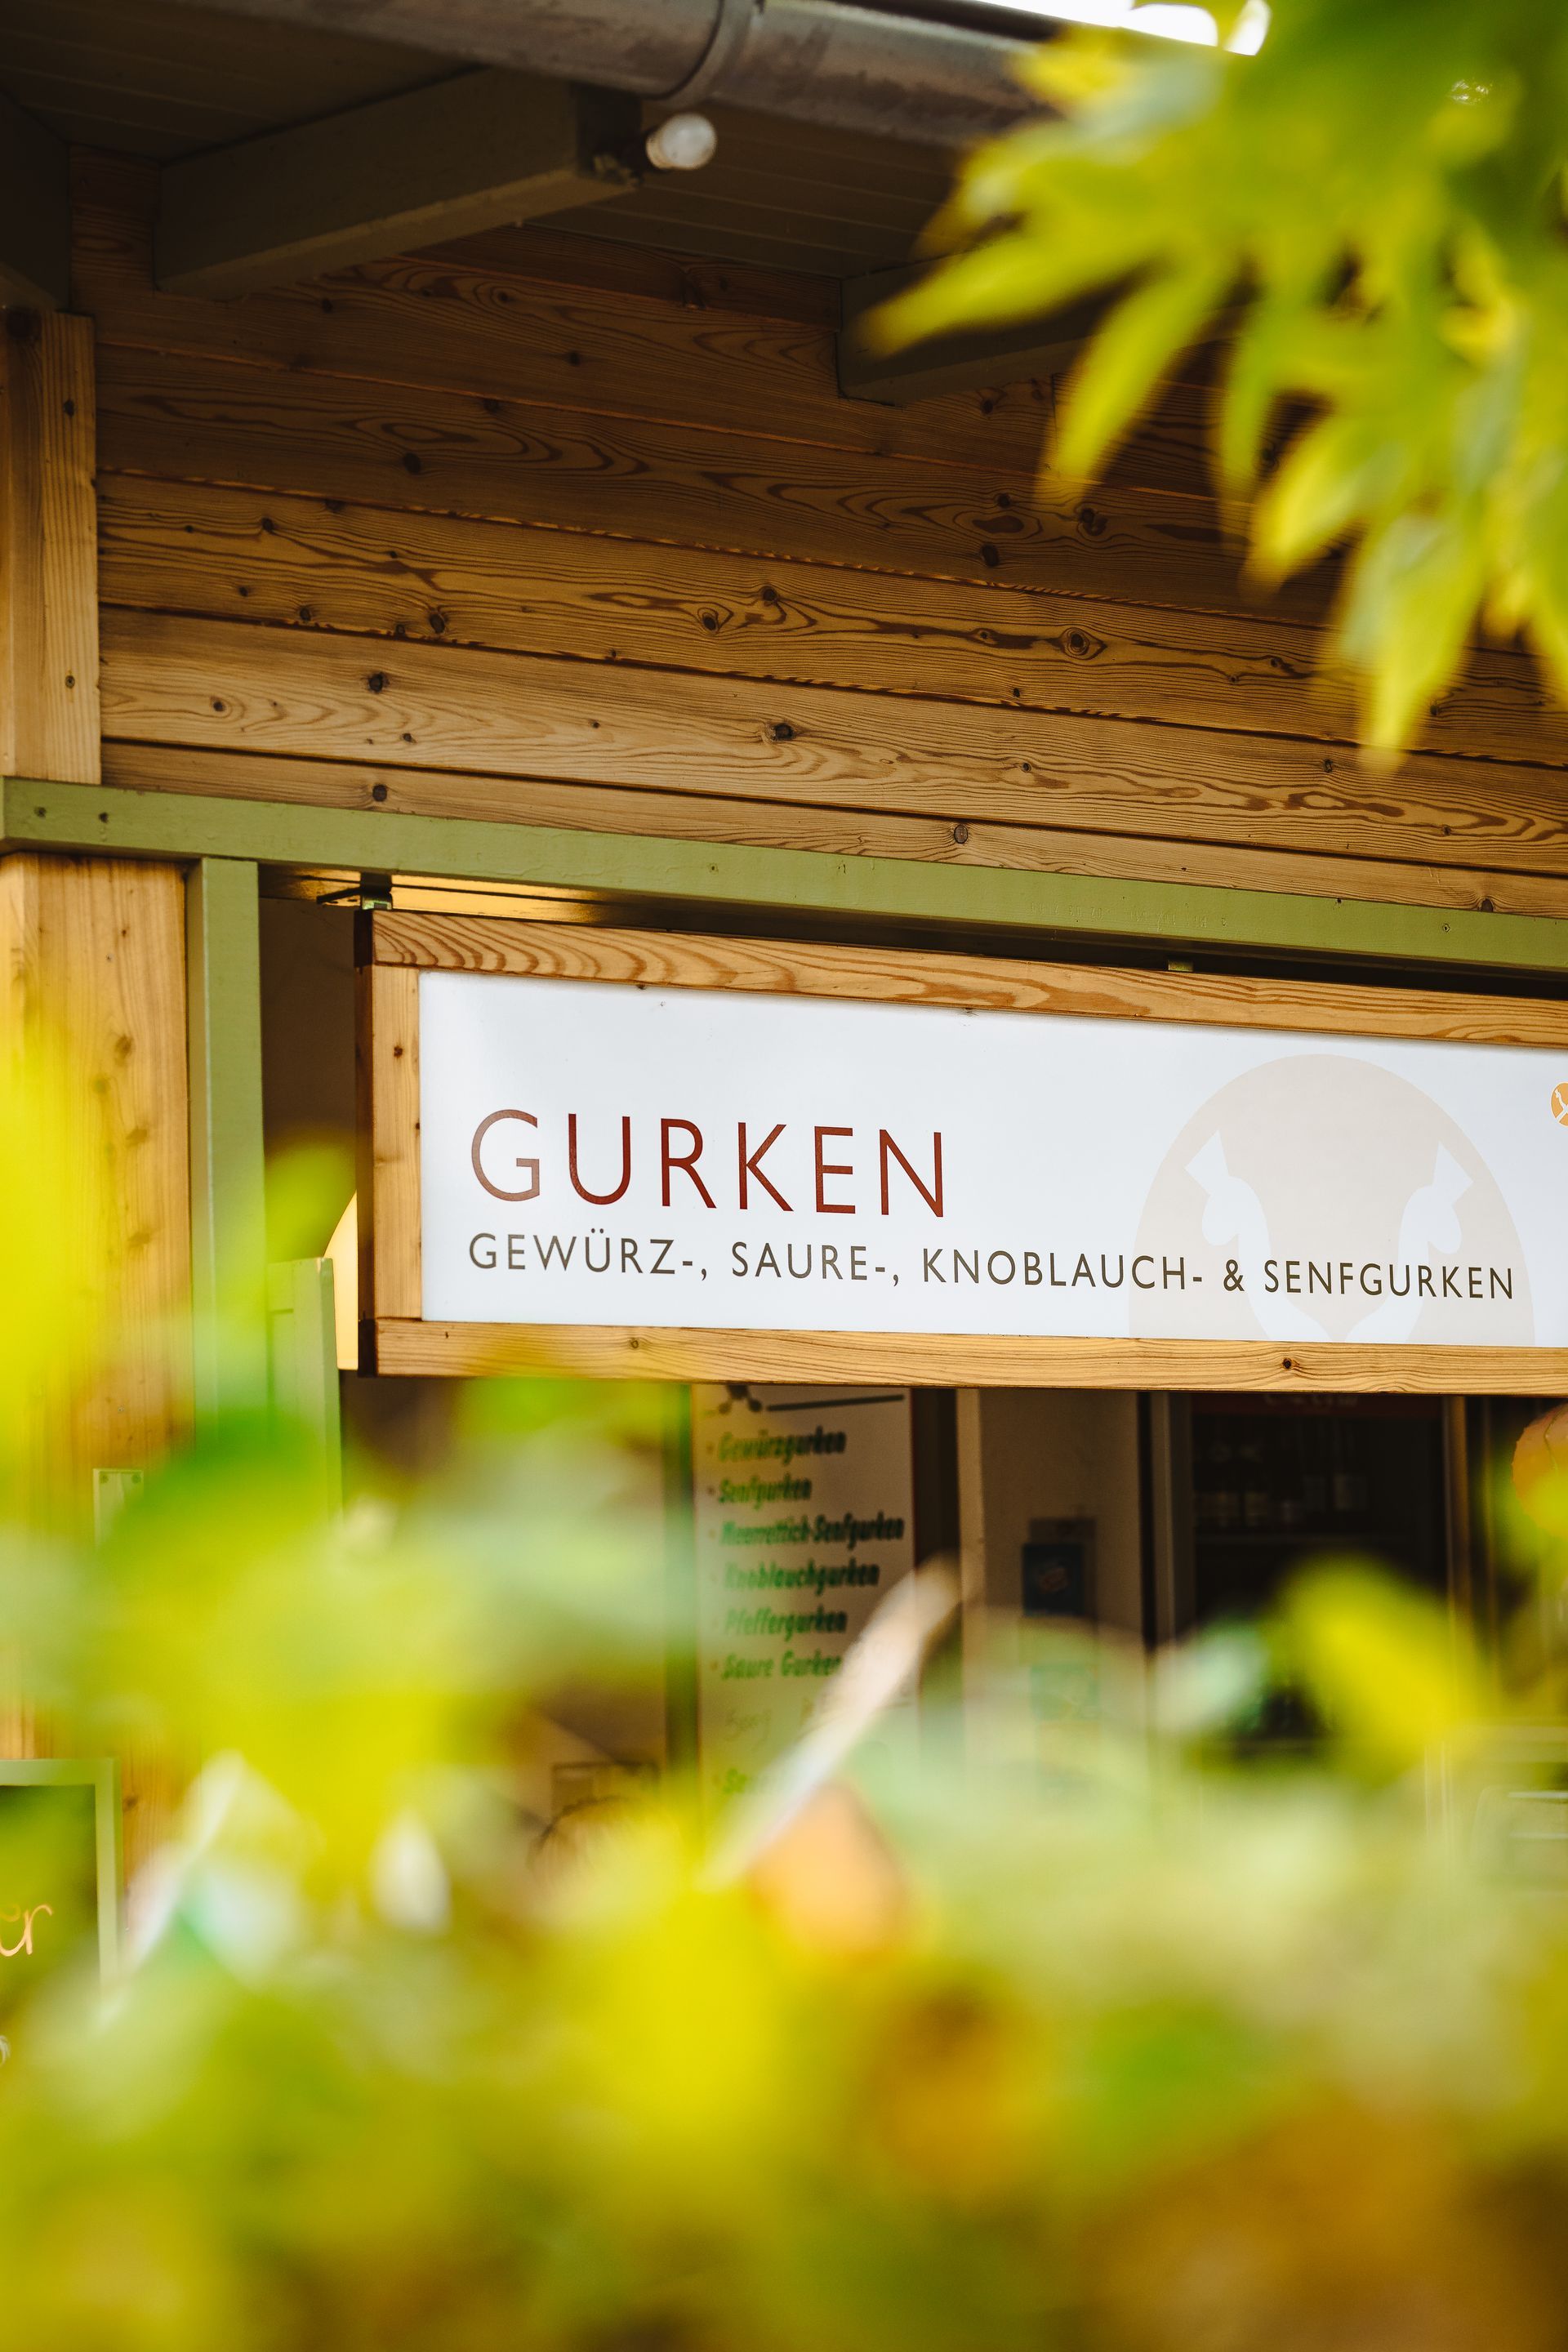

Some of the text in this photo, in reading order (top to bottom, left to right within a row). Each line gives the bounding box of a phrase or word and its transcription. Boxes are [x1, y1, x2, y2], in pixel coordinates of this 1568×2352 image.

[471, 1109, 944, 1218] GURKEN
[469, 1227, 1513, 1299] GEWÜRZ-, SAURE-, KNOBLAUCH- & SENFGURKEN
[719, 1425, 847, 1467] Gewürzgurken
[719, 1472, 812, 1511] Senfgurken
[724, 1557, 880, 1597] Knoblauchgurken
[724, 1603, 848, 1642] Pfeffergurken
[723, 1651, 774, 1681] Saure
